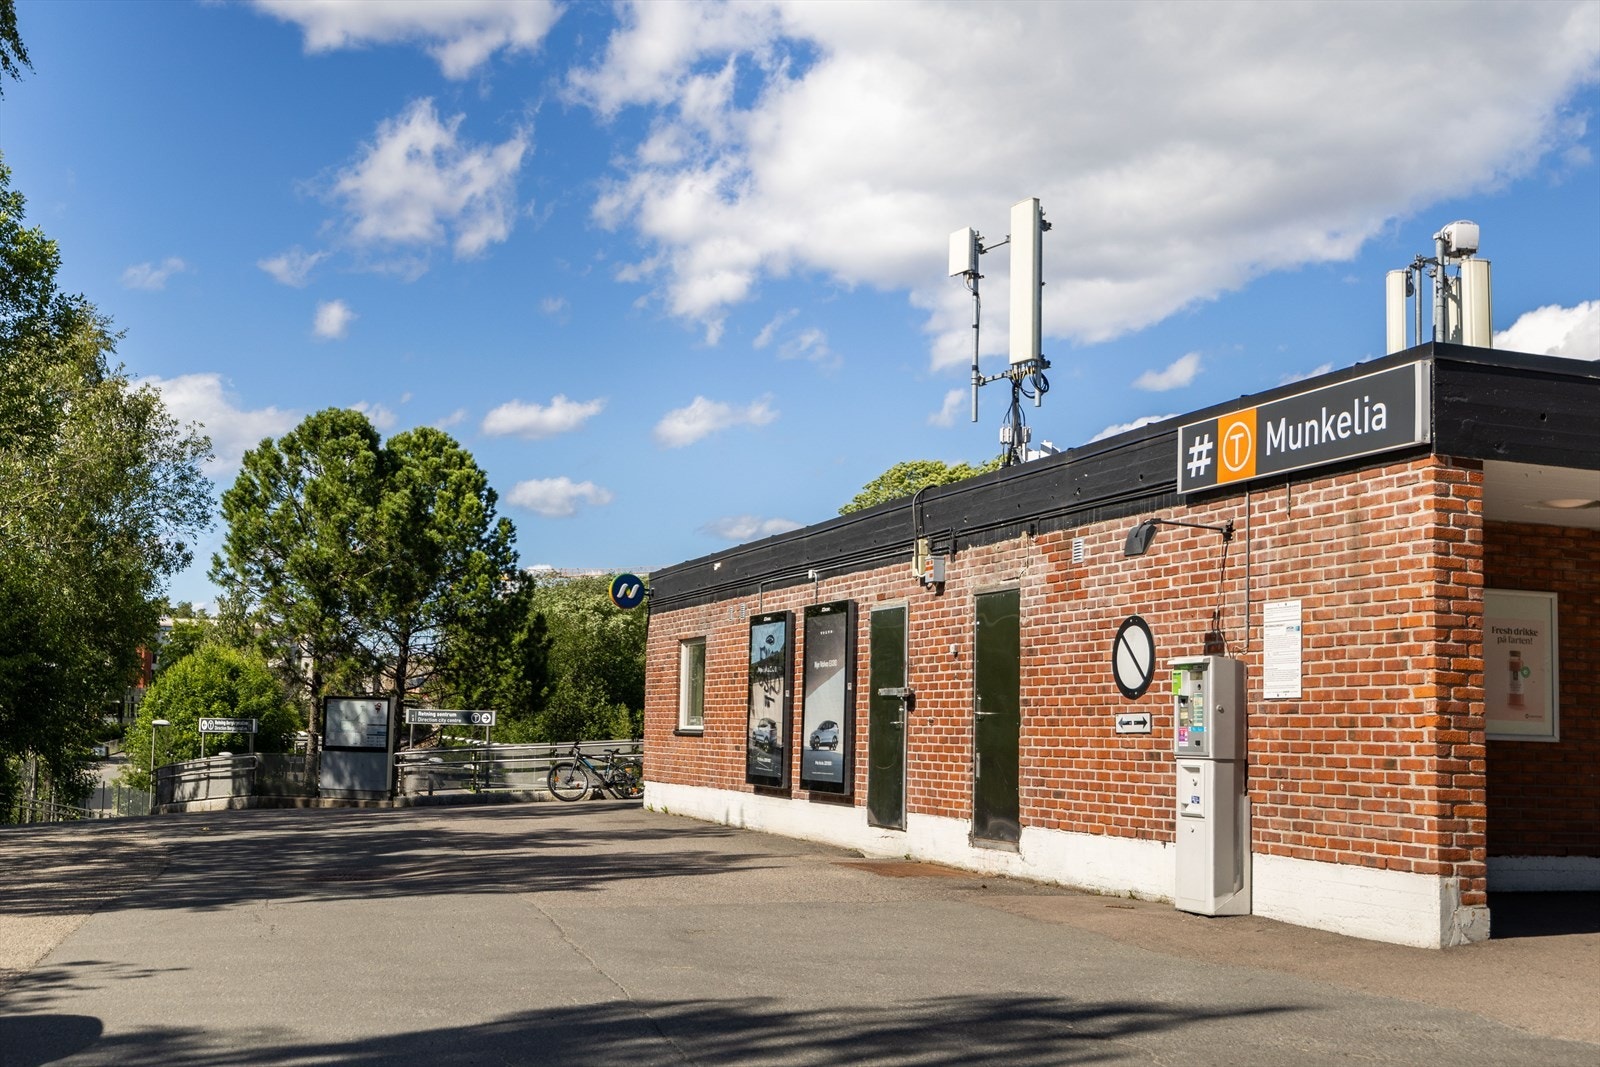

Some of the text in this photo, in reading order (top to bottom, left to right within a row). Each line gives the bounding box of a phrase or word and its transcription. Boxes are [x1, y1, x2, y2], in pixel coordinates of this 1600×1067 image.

[1266, 396, 1387, 456] Munkelia
[1491, 626, 1538, 637] Fresh drikke
